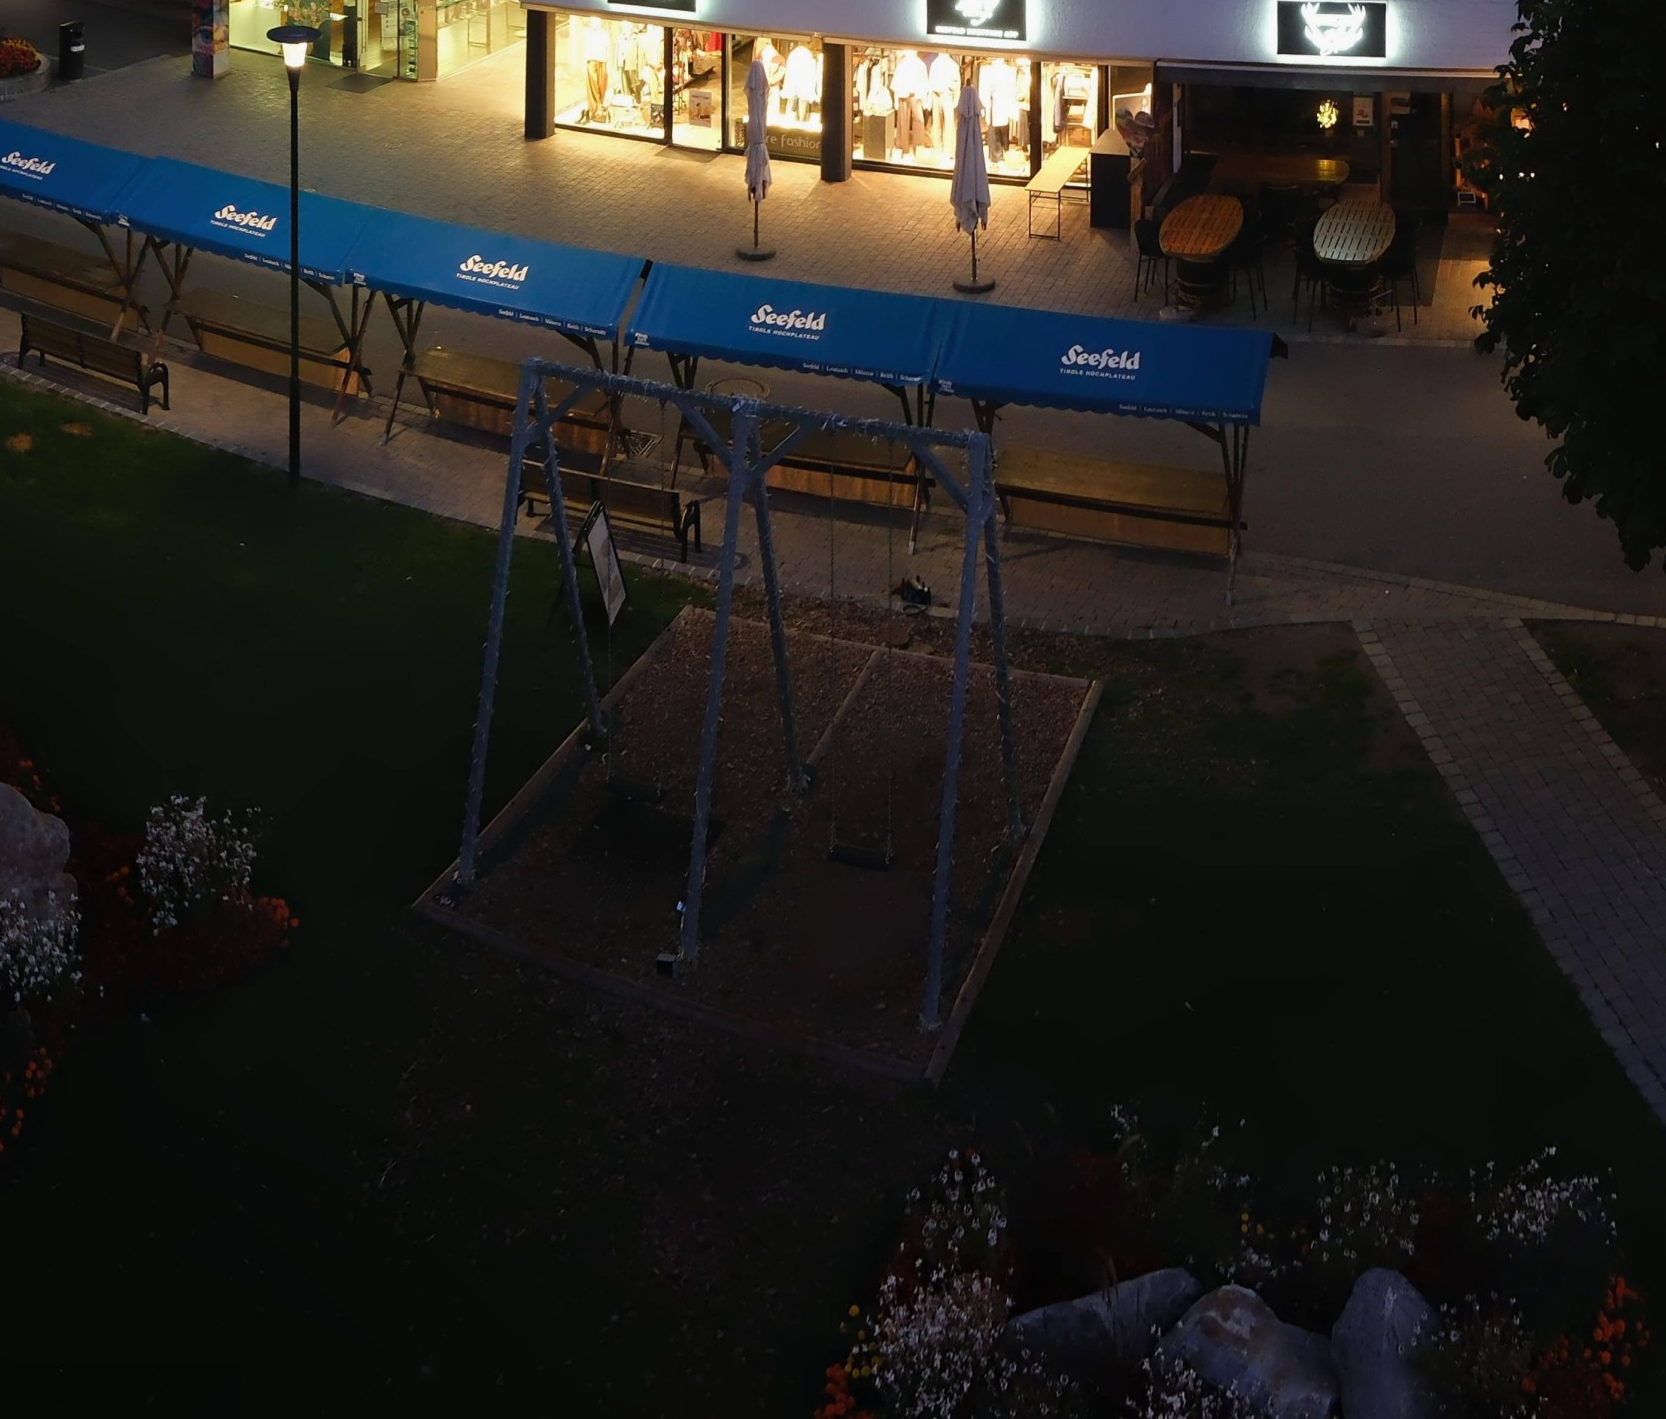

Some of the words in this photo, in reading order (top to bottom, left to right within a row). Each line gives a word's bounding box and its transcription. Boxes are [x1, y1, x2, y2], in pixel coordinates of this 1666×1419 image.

[1, 150, 57, 175] Seefeld
[214, 204, 278, 231] Seefeld
[460, 253, 529, 282] Seefeld
[750, 303, 827, 332] Seefeld
[1060, 344, 1141, 371] Seefeld
[1059, 367, 1084, 377] TIROLS
